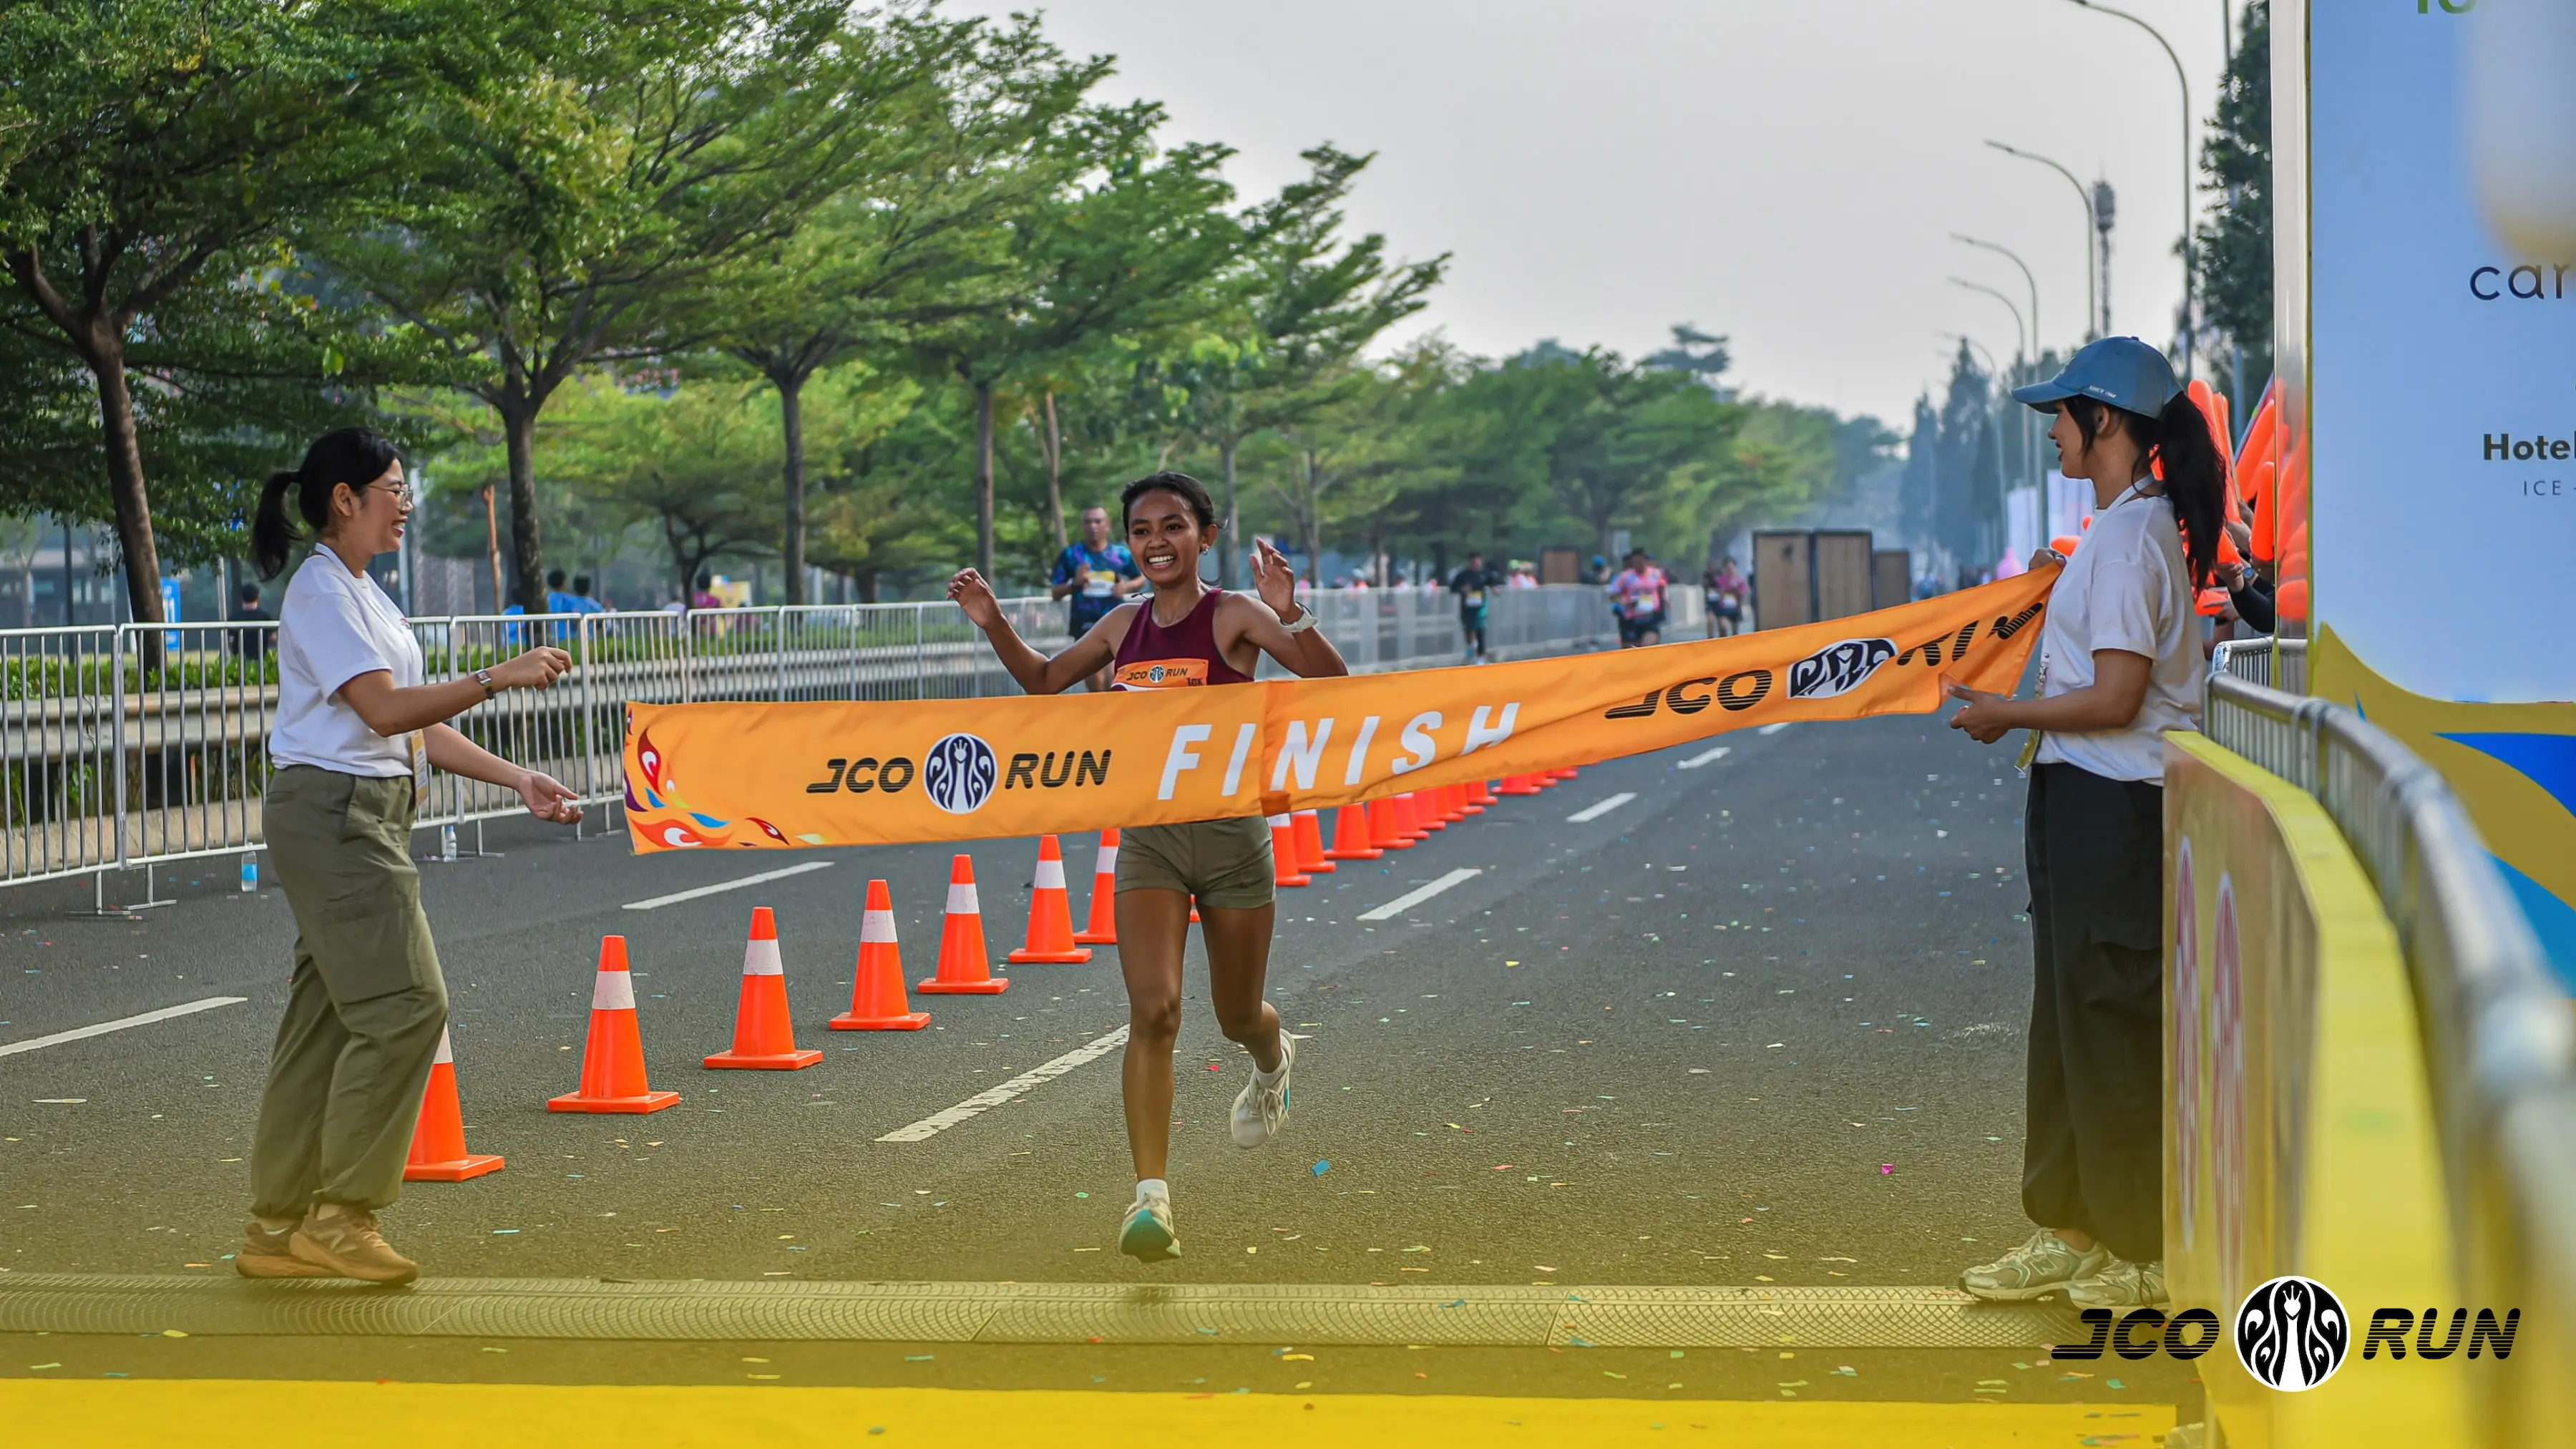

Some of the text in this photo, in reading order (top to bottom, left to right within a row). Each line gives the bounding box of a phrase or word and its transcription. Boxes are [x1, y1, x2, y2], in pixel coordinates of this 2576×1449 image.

[2524, 480, 2562, 496] ICE
[1126, 670, 1148, 681] JCO
[1165, 668, 1188, 678] RUN
[806, 756, 914, 793] JCO
[1005, 749, 1113, 789] RUN
[1156, 702, 1521, 800] FINISH
[1604, 669, 1772, 720] JCO
